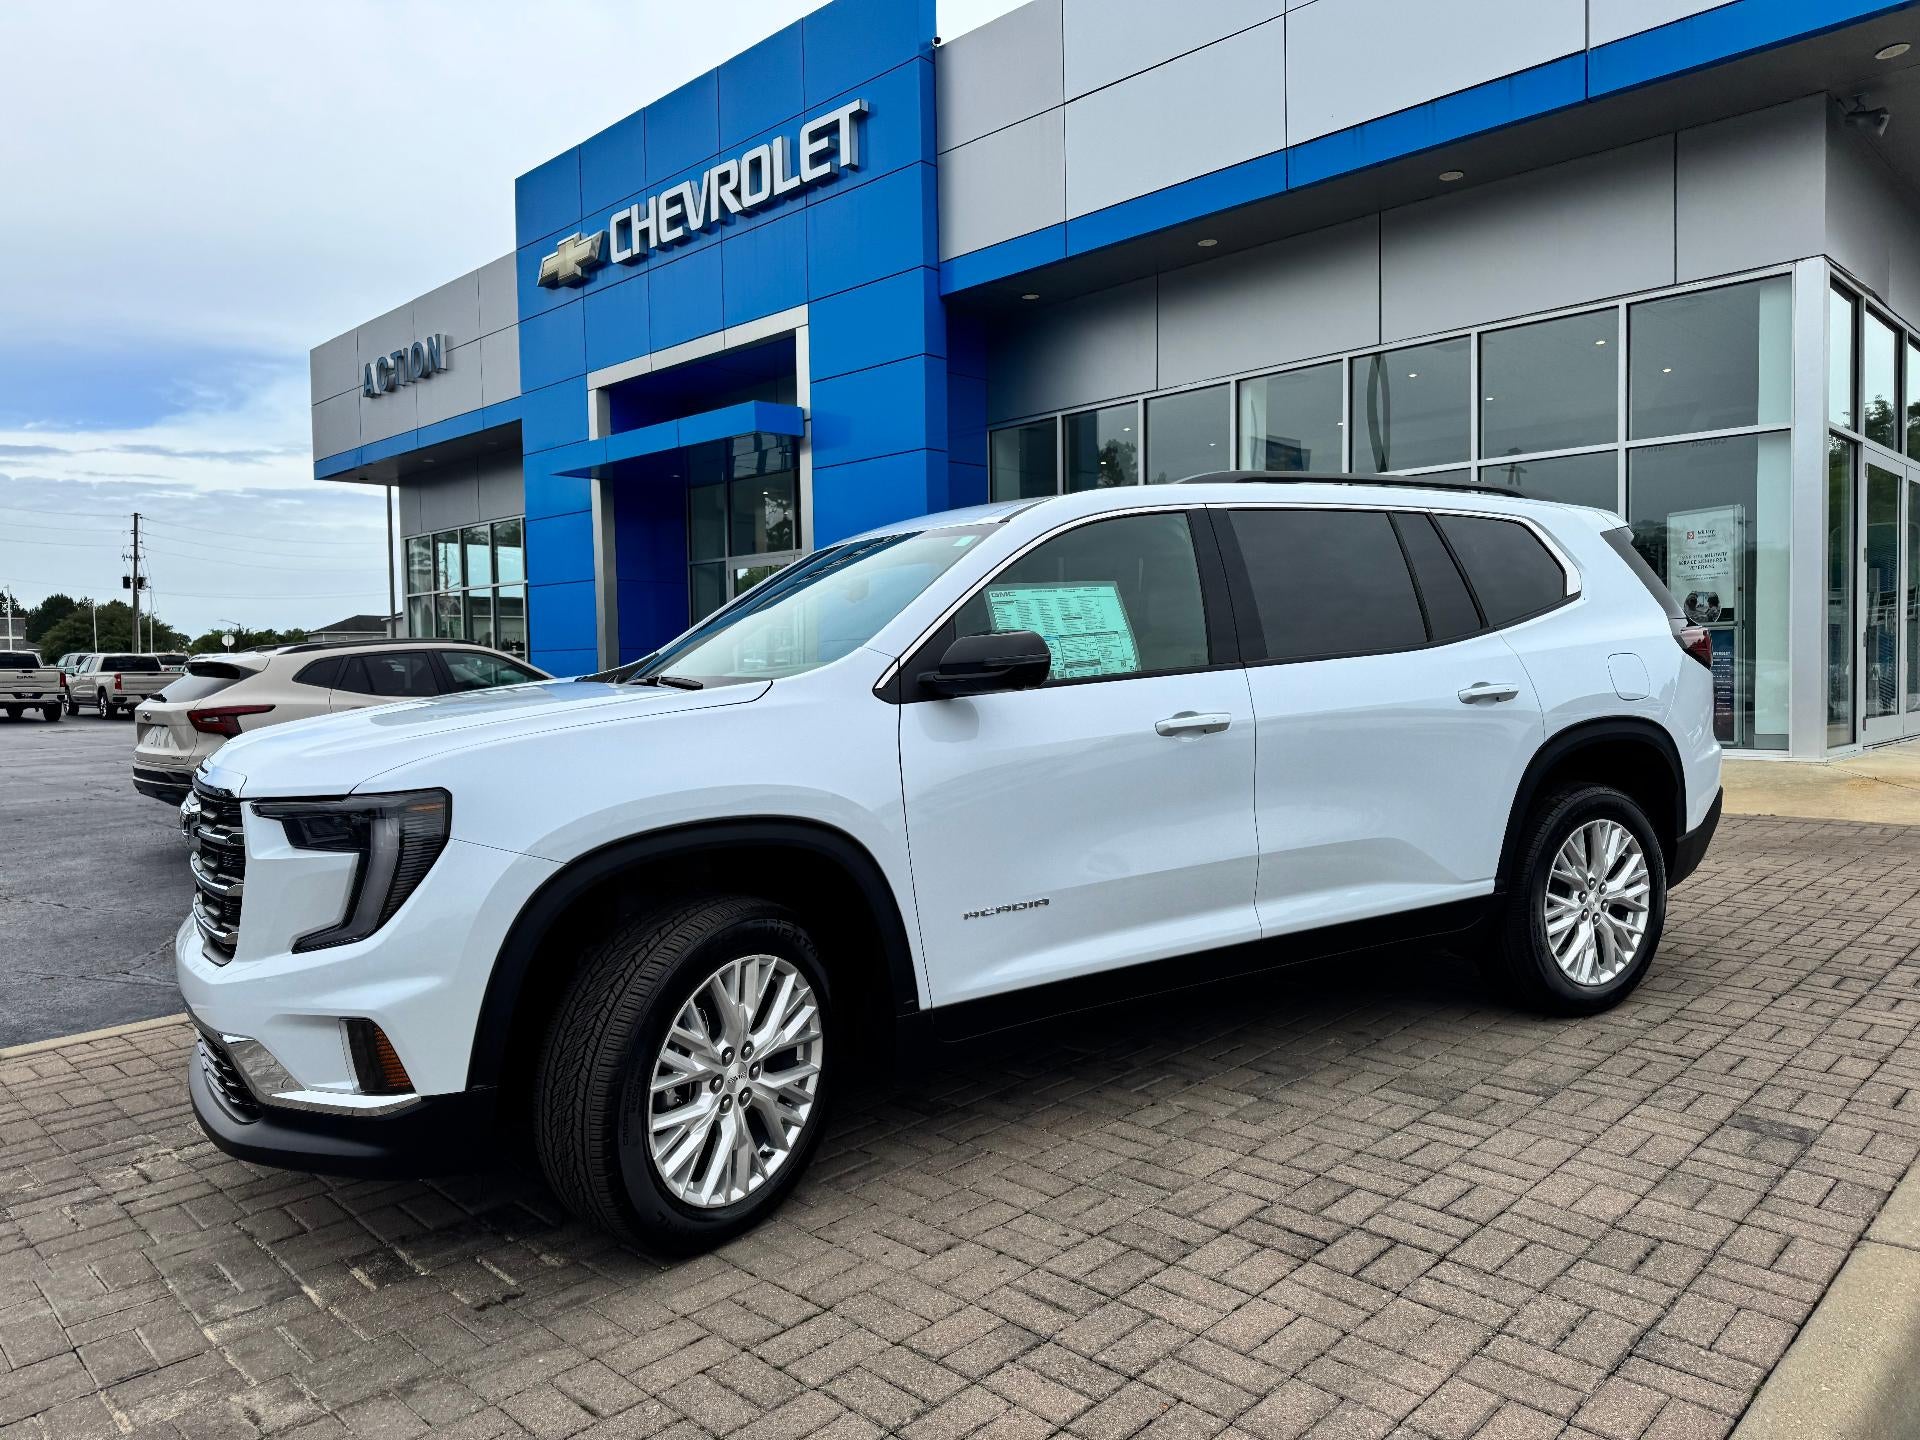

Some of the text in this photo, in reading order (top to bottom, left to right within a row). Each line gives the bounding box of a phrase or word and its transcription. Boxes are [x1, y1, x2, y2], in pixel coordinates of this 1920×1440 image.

[609, 98, 868, 266] CHEVROLET
[363, 333, 447, 398] ACTION
[963, 898, 1050, 920] ACADIA
